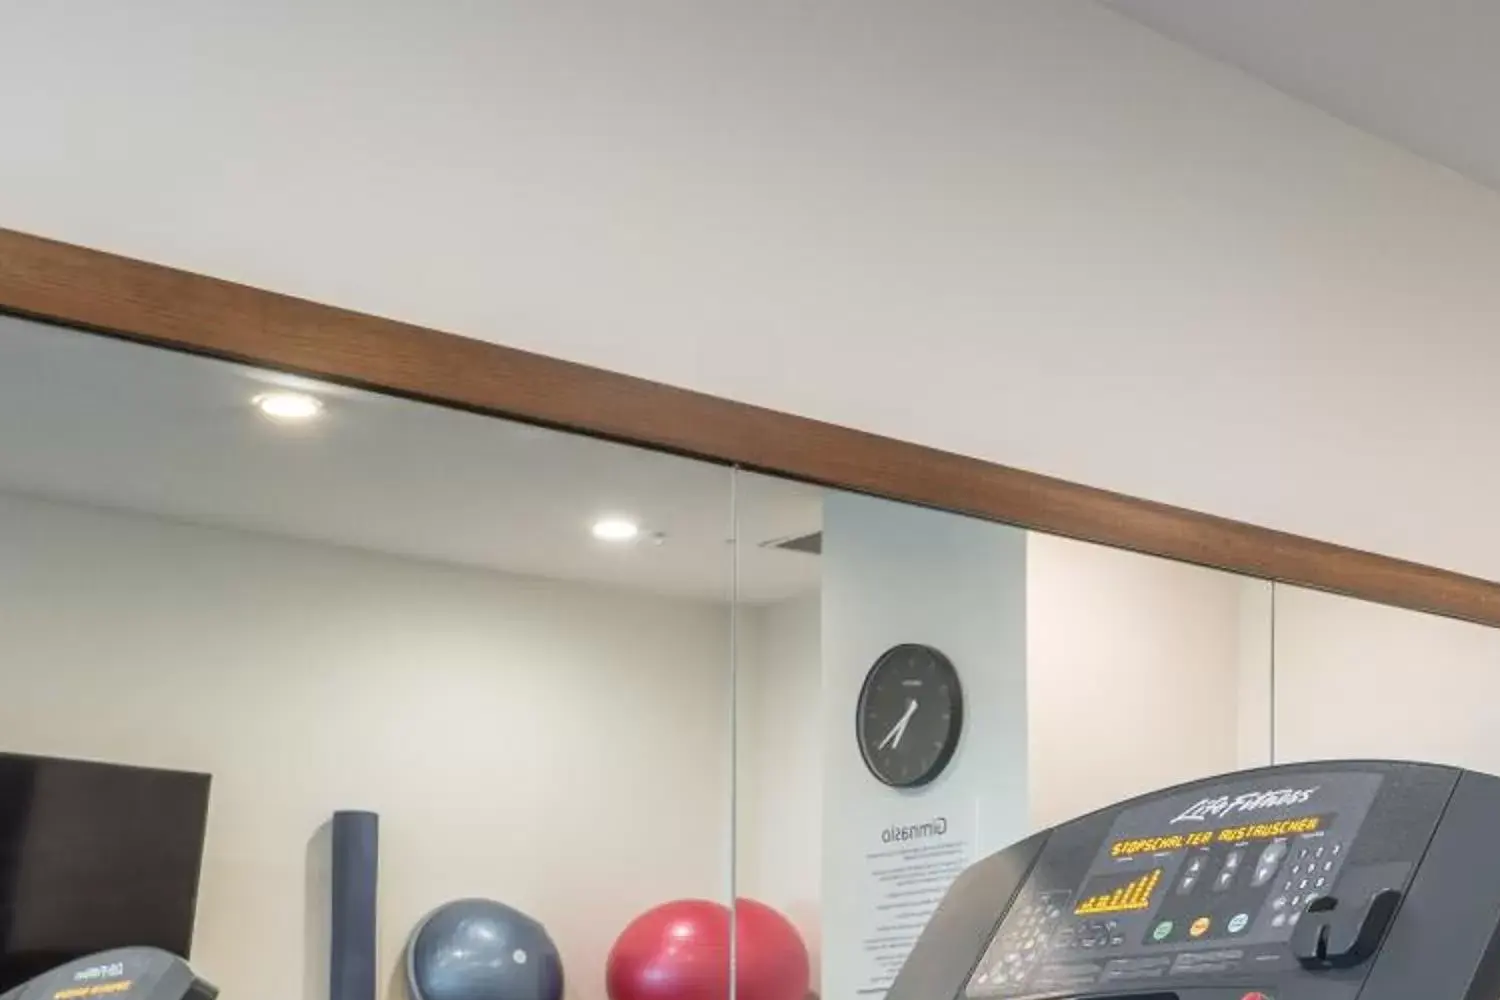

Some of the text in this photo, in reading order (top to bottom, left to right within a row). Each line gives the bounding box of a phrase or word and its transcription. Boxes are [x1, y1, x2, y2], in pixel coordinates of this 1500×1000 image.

[1169, 787, 1320, 825] Life Fitness
[1111, 831, 1213, 857] STOPSCHALTER
